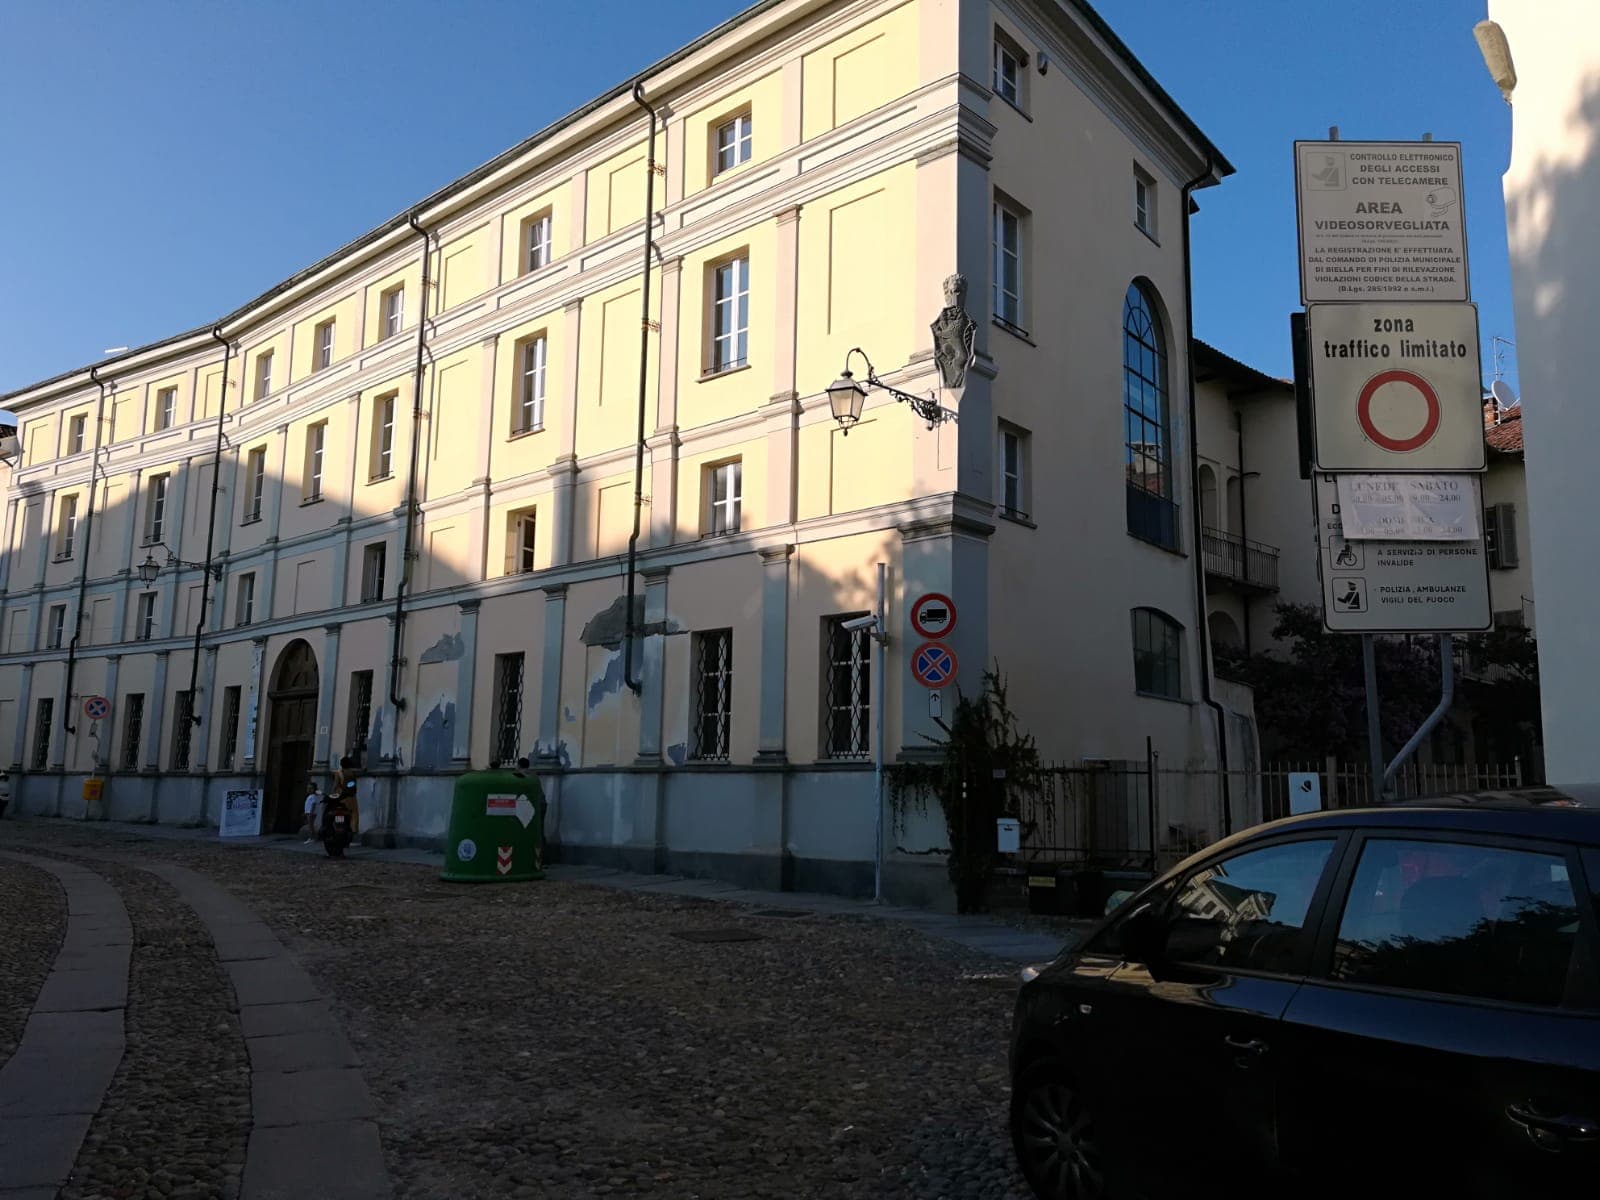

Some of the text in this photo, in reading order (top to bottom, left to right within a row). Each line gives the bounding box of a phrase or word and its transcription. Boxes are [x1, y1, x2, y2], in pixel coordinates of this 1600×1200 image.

[1350, 153, 1397, 161] CONTROLLO
[1360, 165, 1440, 173] DEGLI ACCESSI
[1352, 177, 1448, 185] CON TELECAMERE
[1355, 202, 1403, 214] AREA
[1315, 220, 1450, 230] VIDEOSORVEGLIATA
[1374, 318, 1414, 333] zona
[1324, 340, 1467, 359] traffico limitato
[1377, 559, 1415, 567] INVALIDE
[1416, 585, 1467, 593] AMBULANZE
[1381, 596, 1455, 604] VIGILI DEL FUOCO
